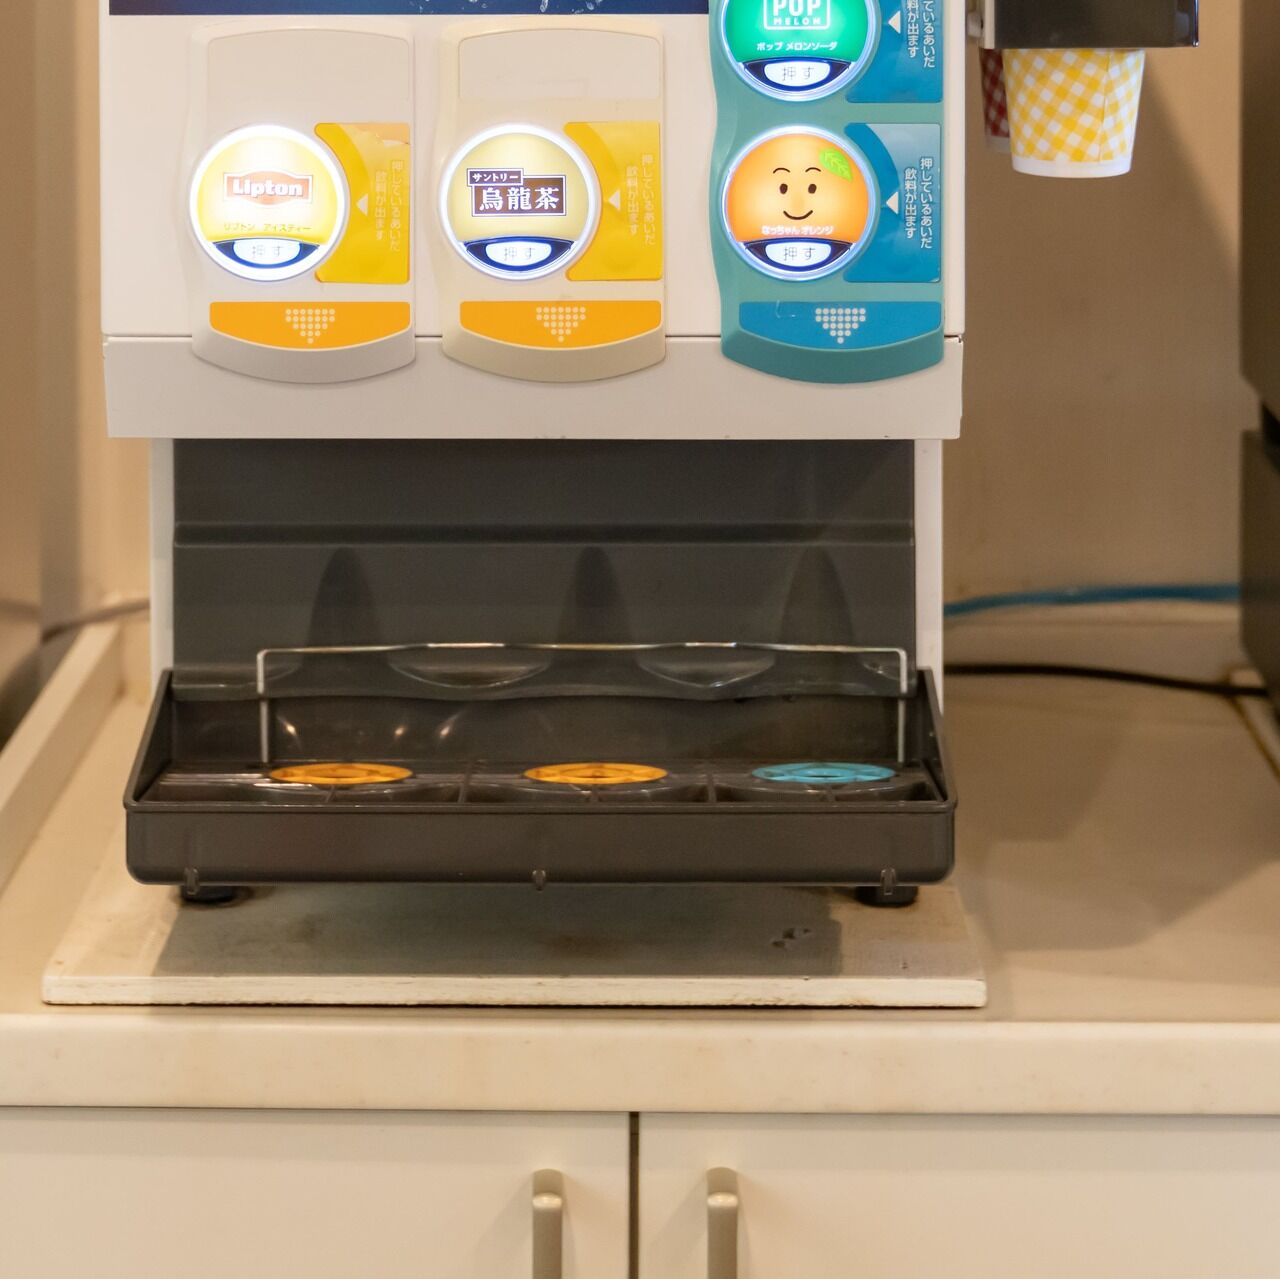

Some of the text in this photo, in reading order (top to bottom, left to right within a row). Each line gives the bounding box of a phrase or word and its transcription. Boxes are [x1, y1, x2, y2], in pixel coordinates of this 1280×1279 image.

[773, 17, 821, 26] MELON
[757, 41, 838, 51] ポップ メロンソーダ
[782, 66, 814, 81] 押す
[472, 173, 519, 183] サントリー
[233, 178, 304, 198] Lipton
[480, 187, 560, 211] 烏龍茶
[905, 168, 917, 239] 飲料が出ます
[920, 157, 933, 249] 押しているあいだ
[784, 246, 816, 261] 押す
